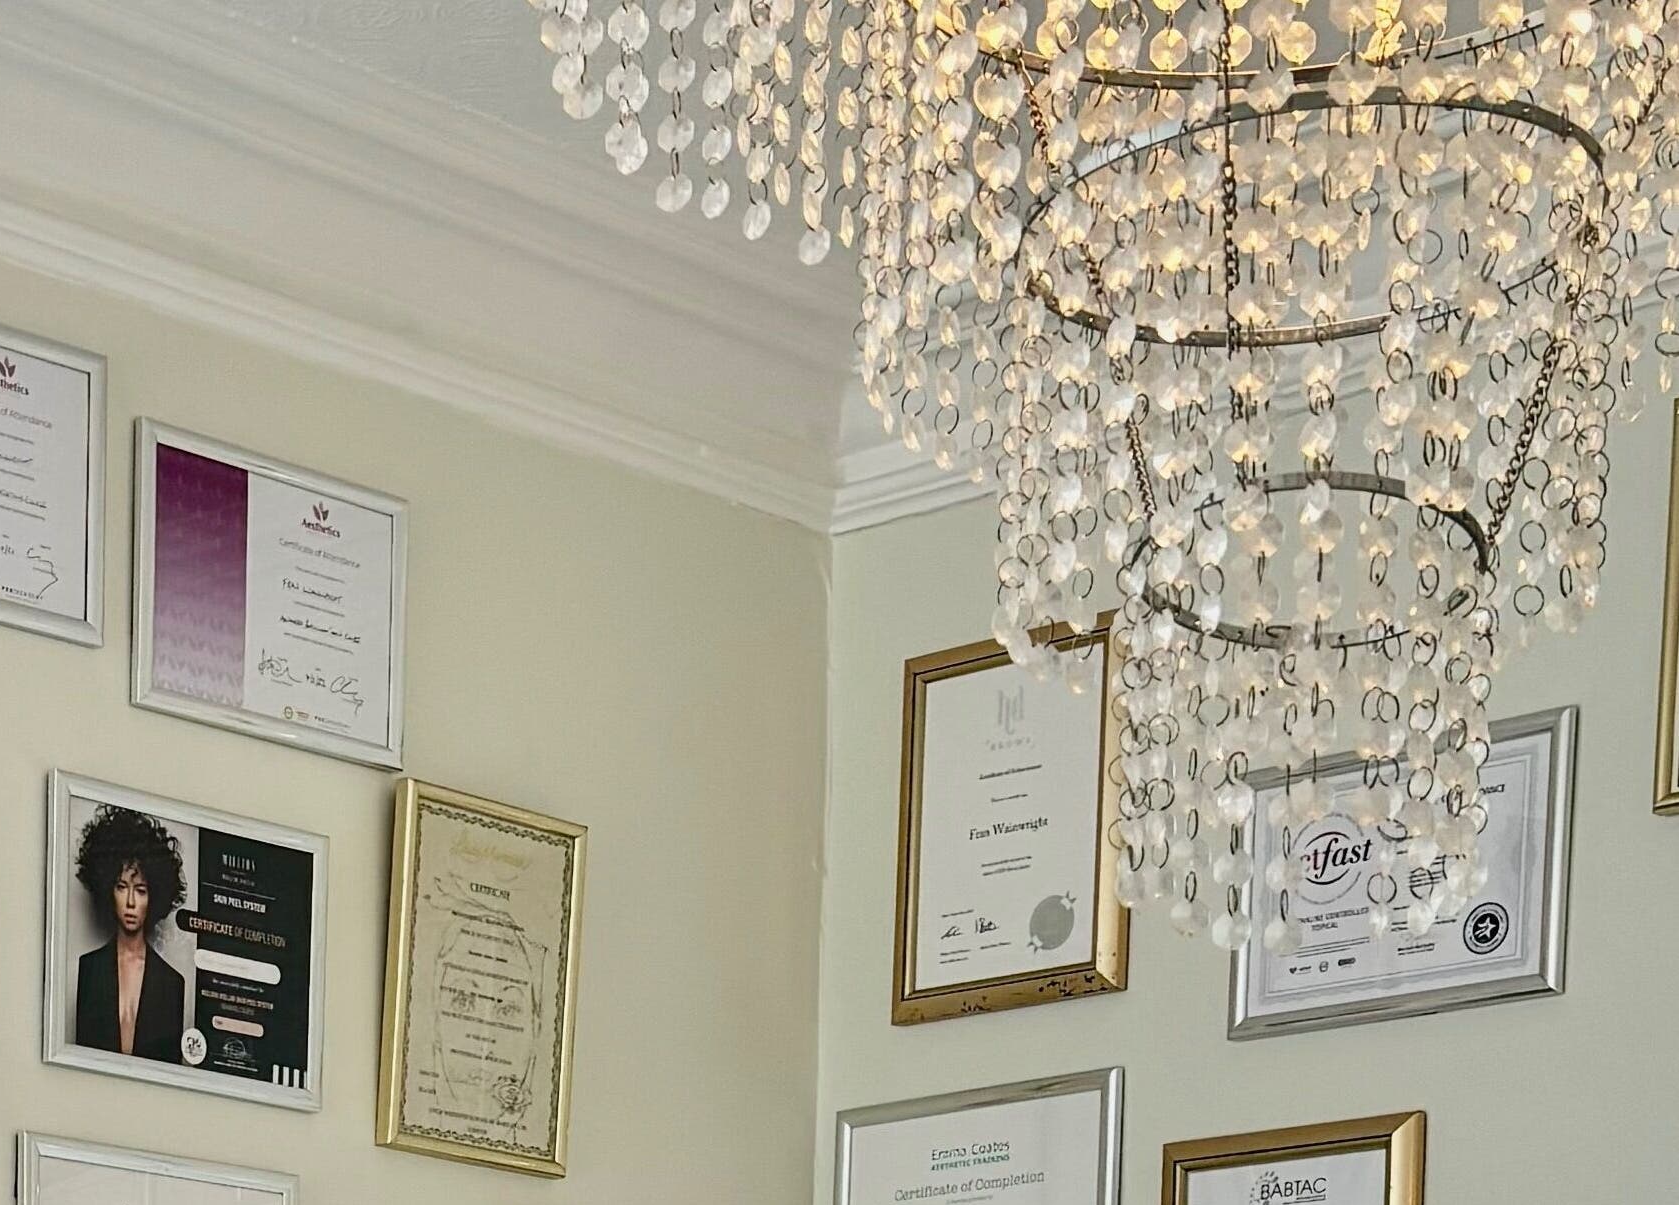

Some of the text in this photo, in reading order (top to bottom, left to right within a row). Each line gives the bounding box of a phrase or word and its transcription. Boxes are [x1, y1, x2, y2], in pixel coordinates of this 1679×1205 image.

[969, 817, 1048, 840] Fran Wainwright
[189, 917, 233, 936] CERTIFICATE
[932, 1141, 1010, 1160] Emma Coates
[895, 1183, 958, 1201] Certificate
[975, 1171, 1044, 1191] Completion
[1260, 1178, 1327, 1200] BABTAC
